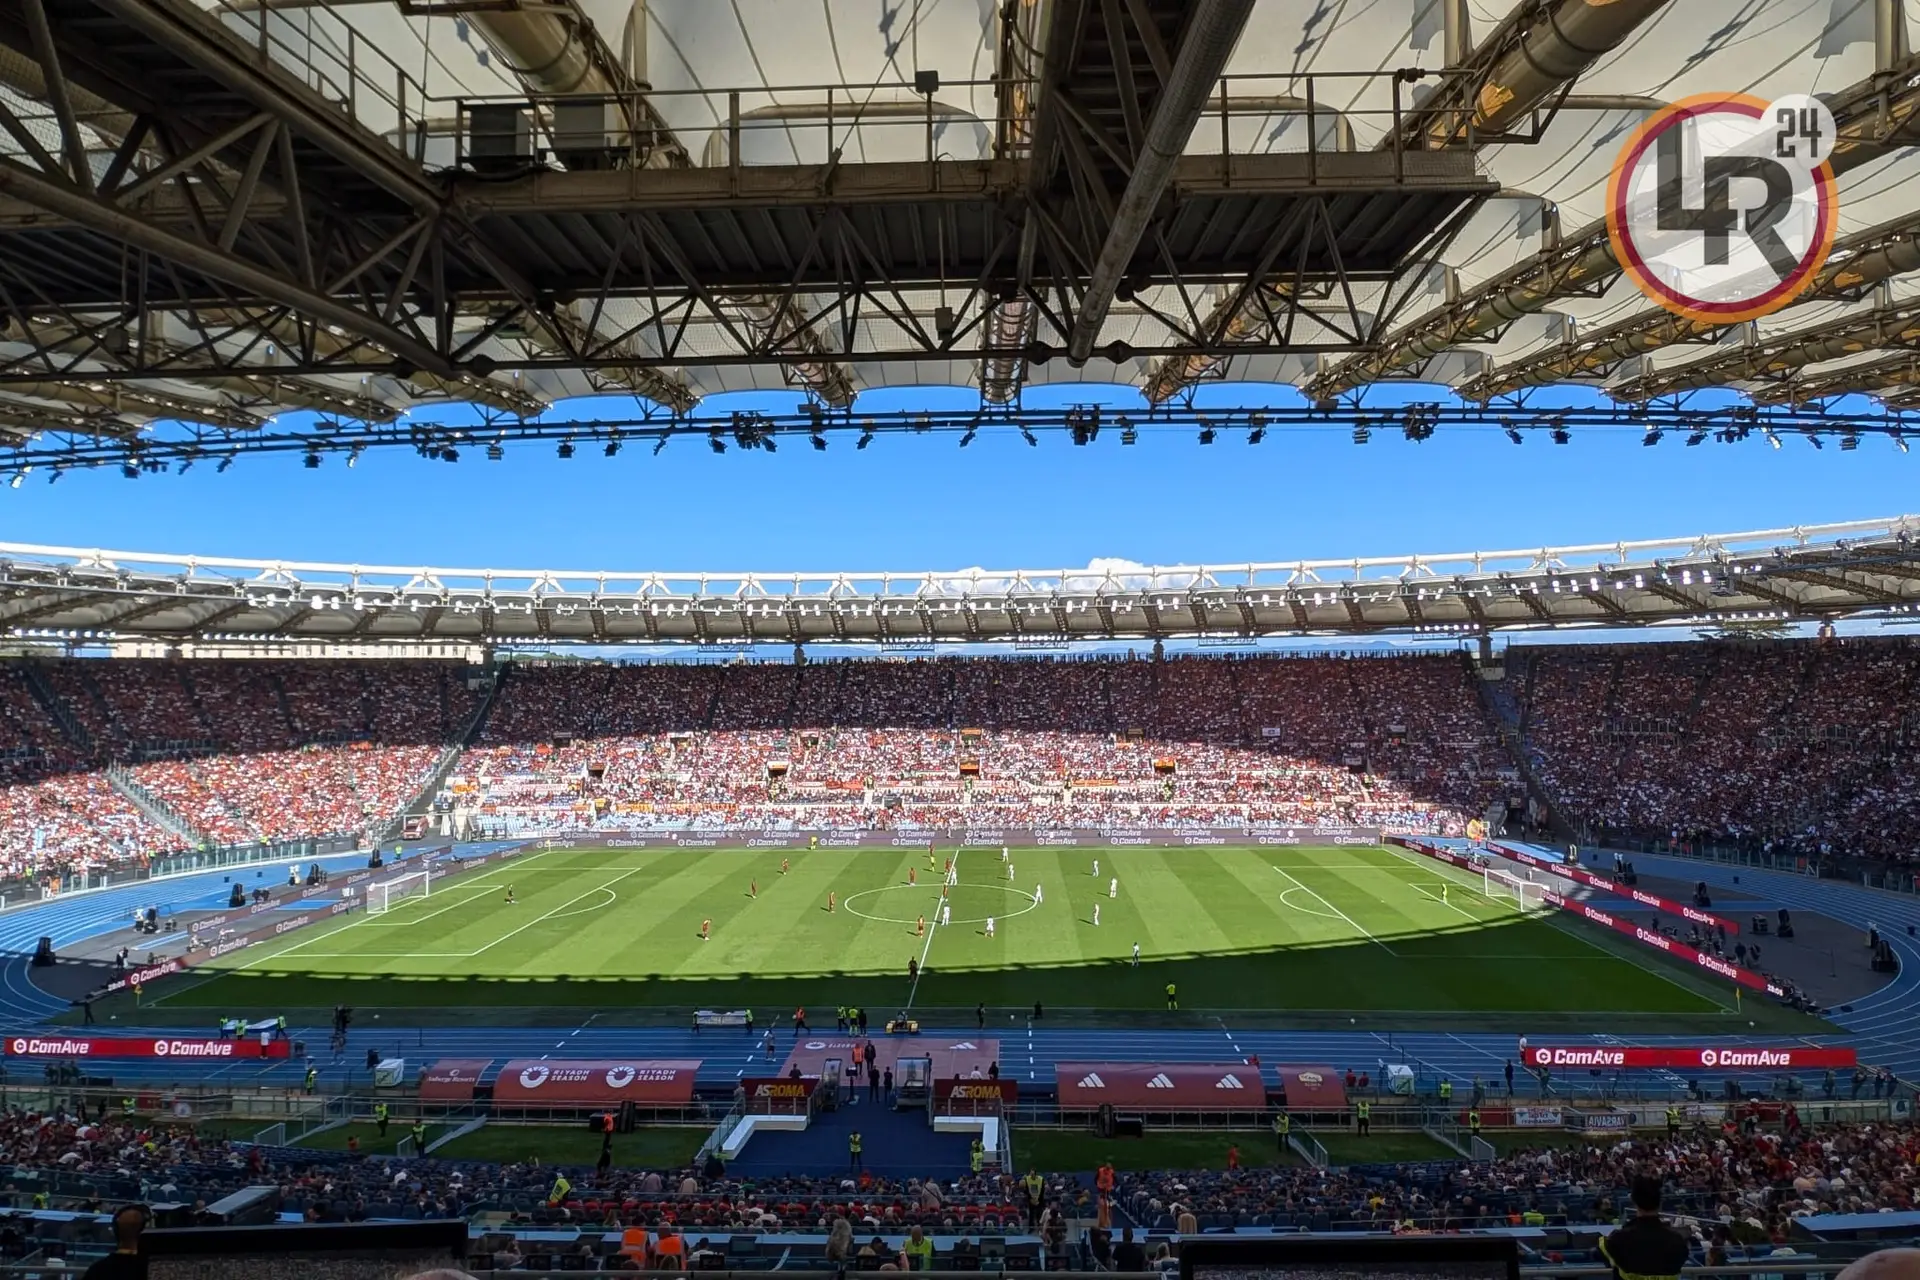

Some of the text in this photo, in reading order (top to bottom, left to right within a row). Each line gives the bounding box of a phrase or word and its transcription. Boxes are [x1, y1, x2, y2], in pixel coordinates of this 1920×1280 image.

[1643, 931, 1670, 950] ComAve
[140, 962, 177, 981] ComAve
[1705, 957, 1738, 978] ComAve
[29, 1040, 89, 1055] ComAve
[170, 1041, 232, 1056] ComAve
[1554, 1050, 1624, 1065] ComAve
[1720, 1050, 1790, 1066] ComAve
